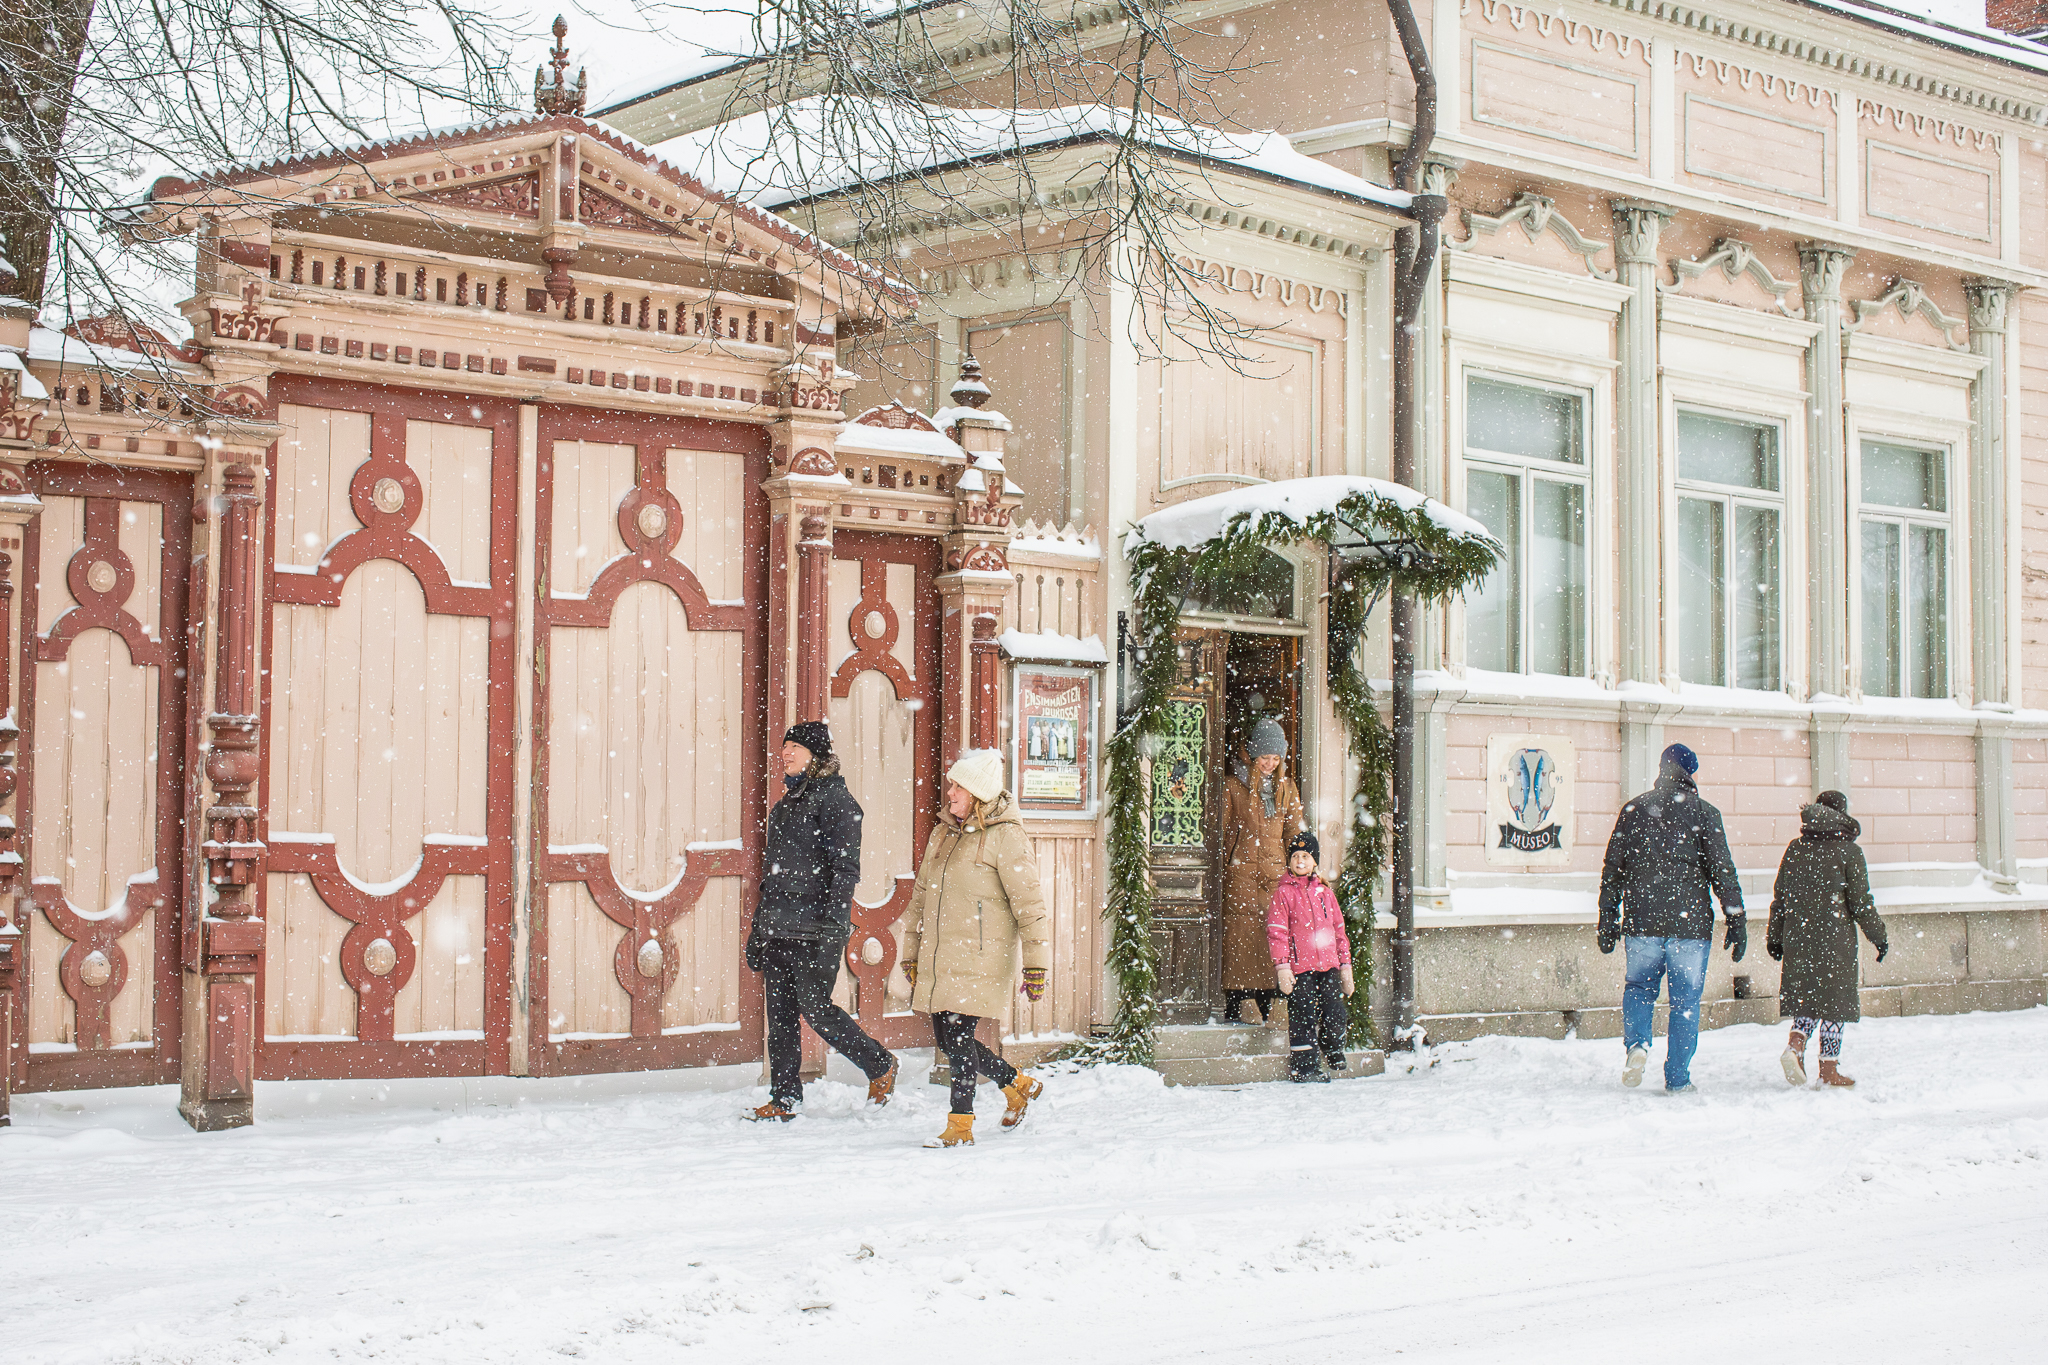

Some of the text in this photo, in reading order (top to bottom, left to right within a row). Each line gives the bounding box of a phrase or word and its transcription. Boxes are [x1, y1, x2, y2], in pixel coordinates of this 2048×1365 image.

[1500, 774, 1563, 784] 18 95
[1510, 831, 1550, 849] MUSEO
